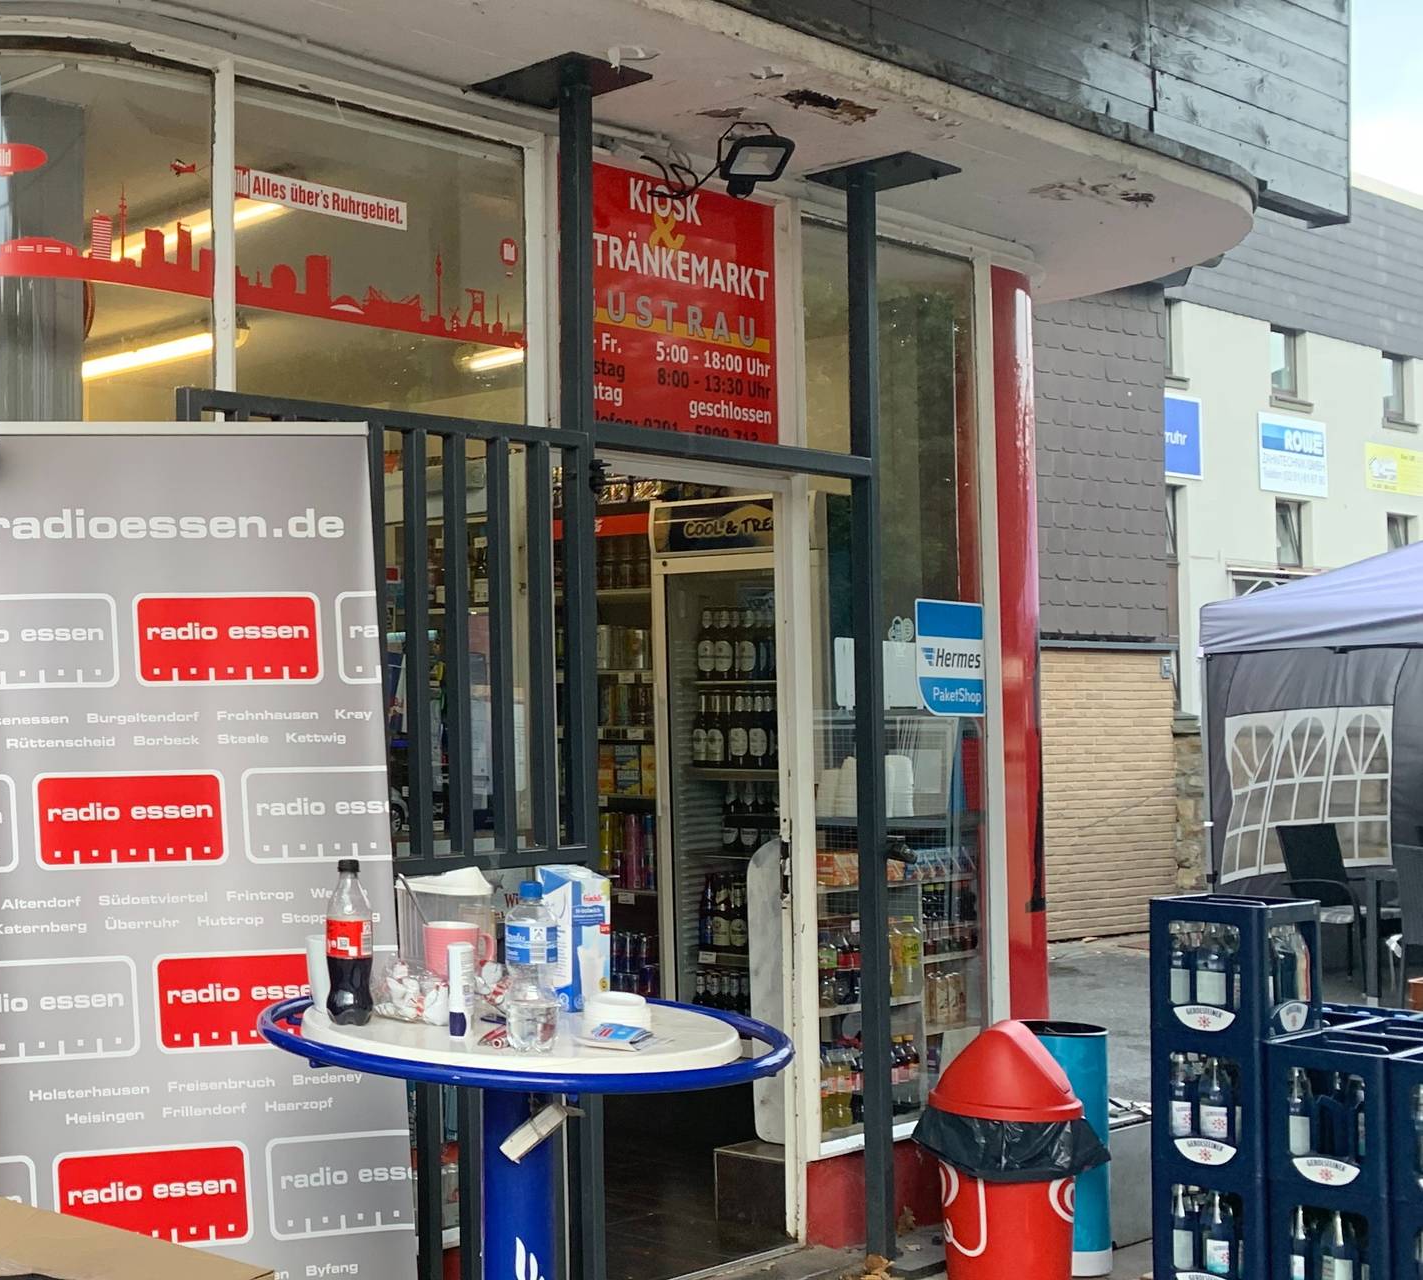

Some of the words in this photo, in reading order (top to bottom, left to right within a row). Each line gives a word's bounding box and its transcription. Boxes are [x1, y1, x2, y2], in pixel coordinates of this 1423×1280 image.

[234, 169, 249, 193] ild
[253, 176, 287, 200] Alles
[290, 183, 329, 209] über's
[332, 192, 403, 225] Ruhrgebiet.
[629, 177, 701, 226] KIOSK
[593, 231, 770, 302] TRÄNKEMARKT
[592, 288, 757, 348] USTRAU
[601, 332, 622, 354] Fr.
[656, 341, 689, 365] 5:00
[704, 350, 743, 373] 18:00
[746, 356, 771, 379] Uhr
[593, 359, 625, 384] stag
[657, 367, 690, 389] 8:00
[704, 375, 743, 397] 13:30
[747, 380, 771, 399] Uhr
[593, 385, 623, 407] ntag
[689, 399, 772, 425] geschlossen
[1283, 429, 1324, 455] ROWE
[684, 520, 723, 538] COOL
[21, 625, 105, 642] essen
[146, 622, 218, 642] radio
[228, 624, 310, 640] essen
[935, 648, 982, 669] Hermes
[932, 686, 982, 706] PaketShop
[86, 711, 201, 726] Burgaltendorf
[216, 709, 320, 723] Frohnhausen
[334, 708, 373, 722] Kray
[5, 734, 116, 750] Rüttenscheid
[132, 734, 200, 747] Borbeck
[217, 733, 269, 745] Steele
[285, 731, 347, 746] Kettwig
[47, 802, 121, 823] radio
[130, 803, 214, 820] essen
[256, 798, 326, 817] radio
[335, 800, 390, 816] ess
[0, 896, 82, 911] Altendorf
[98, 891, 209, 907] Südostviertel
[226, 889, 295, 903] Frintrop
[104, 915, 180, 931] Überruhr
[197, 913, 265, 928] Huttrop
[281, 911, 381, 928] Stoppg
[39, 990, 124, 1009] essen
[166, 983, 241, 1004] radio
[250, 984, 311, 1001] esse
[28, 1084, 151, 1101] Holsterhausen
[167, 1076, 276, 1093] Freisenbruch
[292, 1071, 364, 1087] Bredeney
[64, 1110, 145, 1126] Heisingen
[161, 1102, 248, 1119] Frillendorf
[264, 1097, 334, 1112] Haarzopf
[279, 1167, 349, 1190] radio
[357, 1165, 414, 1184] ess
[67, 1181, 143, 1206] radio
[152, 1176, 238, 1199] essen
[305, 1261, 360, 1279] Byfang
